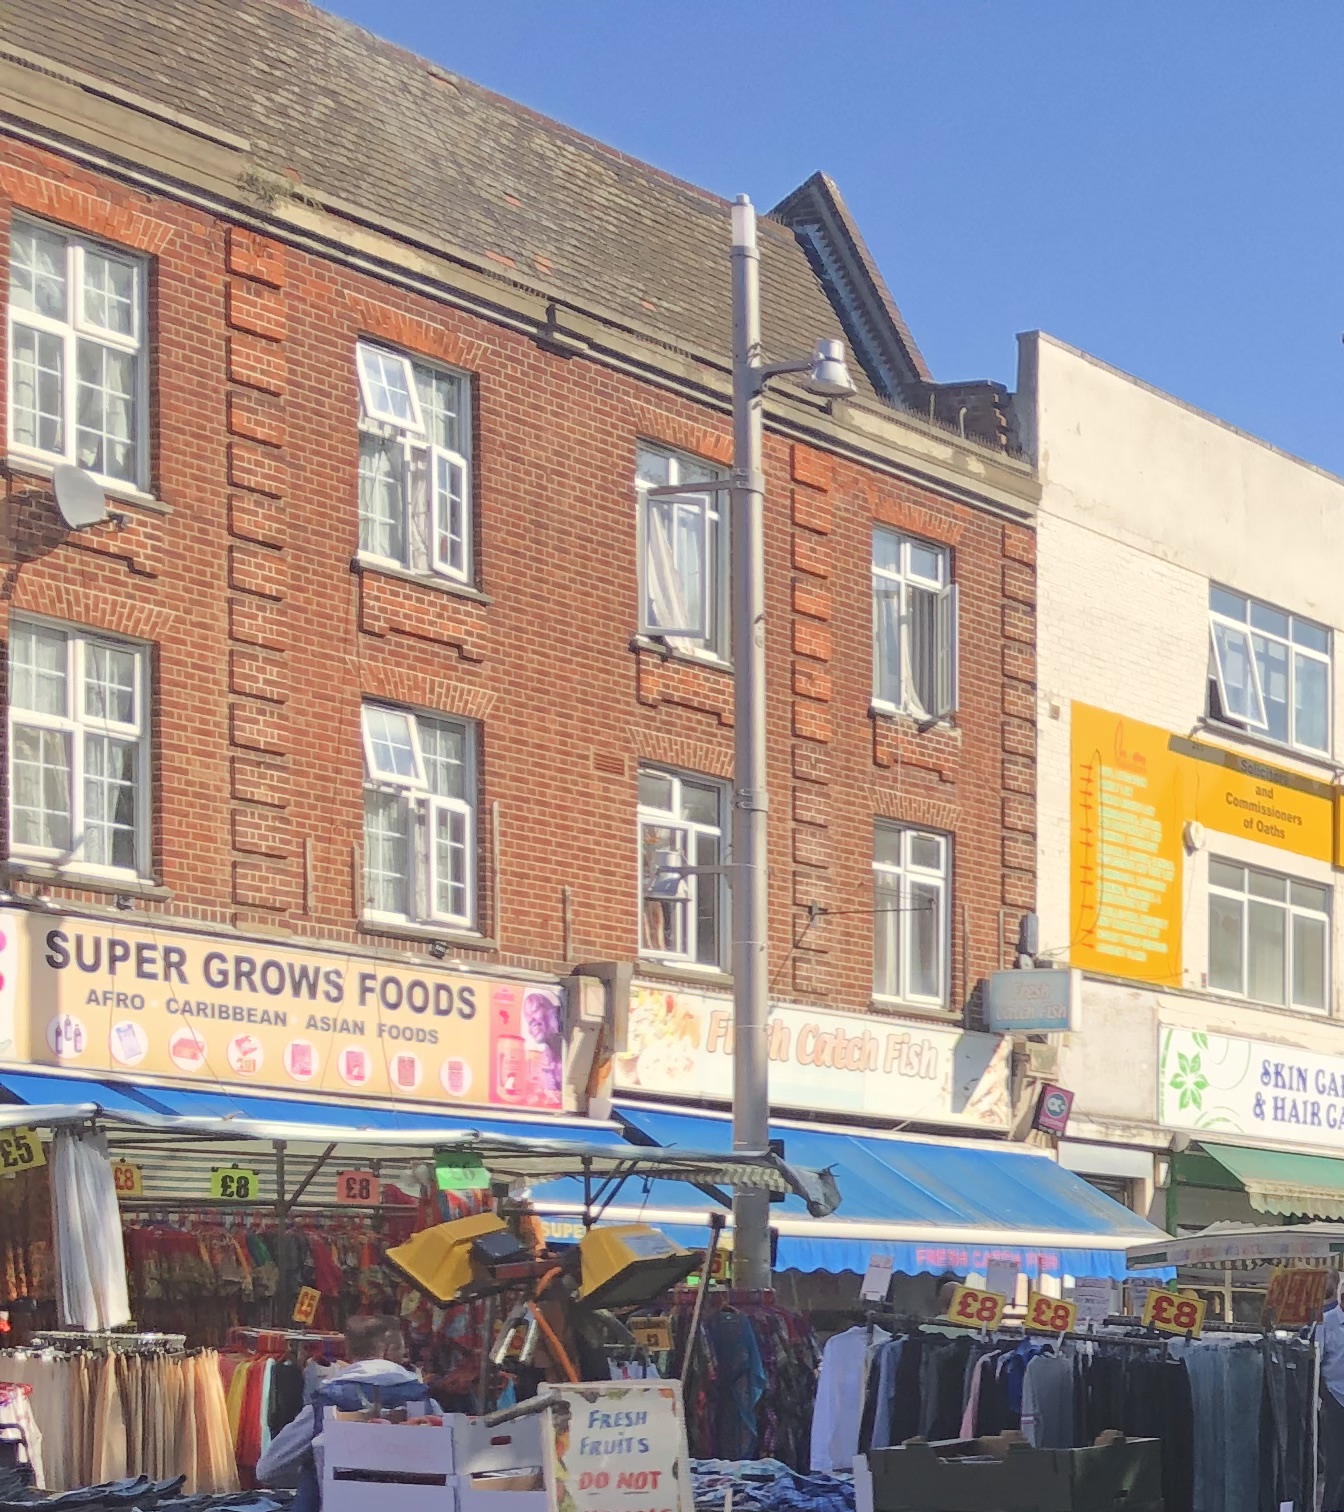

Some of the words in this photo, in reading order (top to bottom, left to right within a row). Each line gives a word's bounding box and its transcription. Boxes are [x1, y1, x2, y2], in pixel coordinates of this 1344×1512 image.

[1241, 760, 1290, 786] Solicitors
[1255, 785, 1274, 800] and
[1226, 791, 1302, 826] Commissioners
[1243, 818, 1254, 830] of
[1256, 822, 1285, 839] Oaths
[45, 929, 188, 985] SUPER
[203, 951, 345, 1004] GROWS
[357, 971, 477, 1021] FOODS
[1015, 982, 1052, 1000] Fresh
[85, 988, 145, 1010] AFRO
[165, 997, 287, 1027] CARIBBEAN
[305, 1014, 366, 1036] ASIAN
[376, 1023, 439, 1045] FOODS
[1042, 1001, 1067, 1020] Fish
[796, 1024, 880, 1073] Catch
[883, 1031, 939, 1080] Fish
[1261, 1059, 1309, 1093] SKIN
[1253, 1091, 1266, 1121] &
[1272, 1096, 1322, 1127] HAIR
[0, 1133, 35, 1169] £5
[114, 1167, 135, 1191] £8
[220, 1173, 250, 1199] £8
[345, 1176, 370, 1200] £8
[916, 1248, 968, 1267] FRESH
[955, 1291, 998, 1322] £8
[1031, 1299, 1070, 1332] £8
[1150, 1295, 1198, 1329] £8
[588, 1409, 648, 1430] FRESH
[578, 1471, 611, 1491] DO
[616, 1470, 663, 1491] NOT
